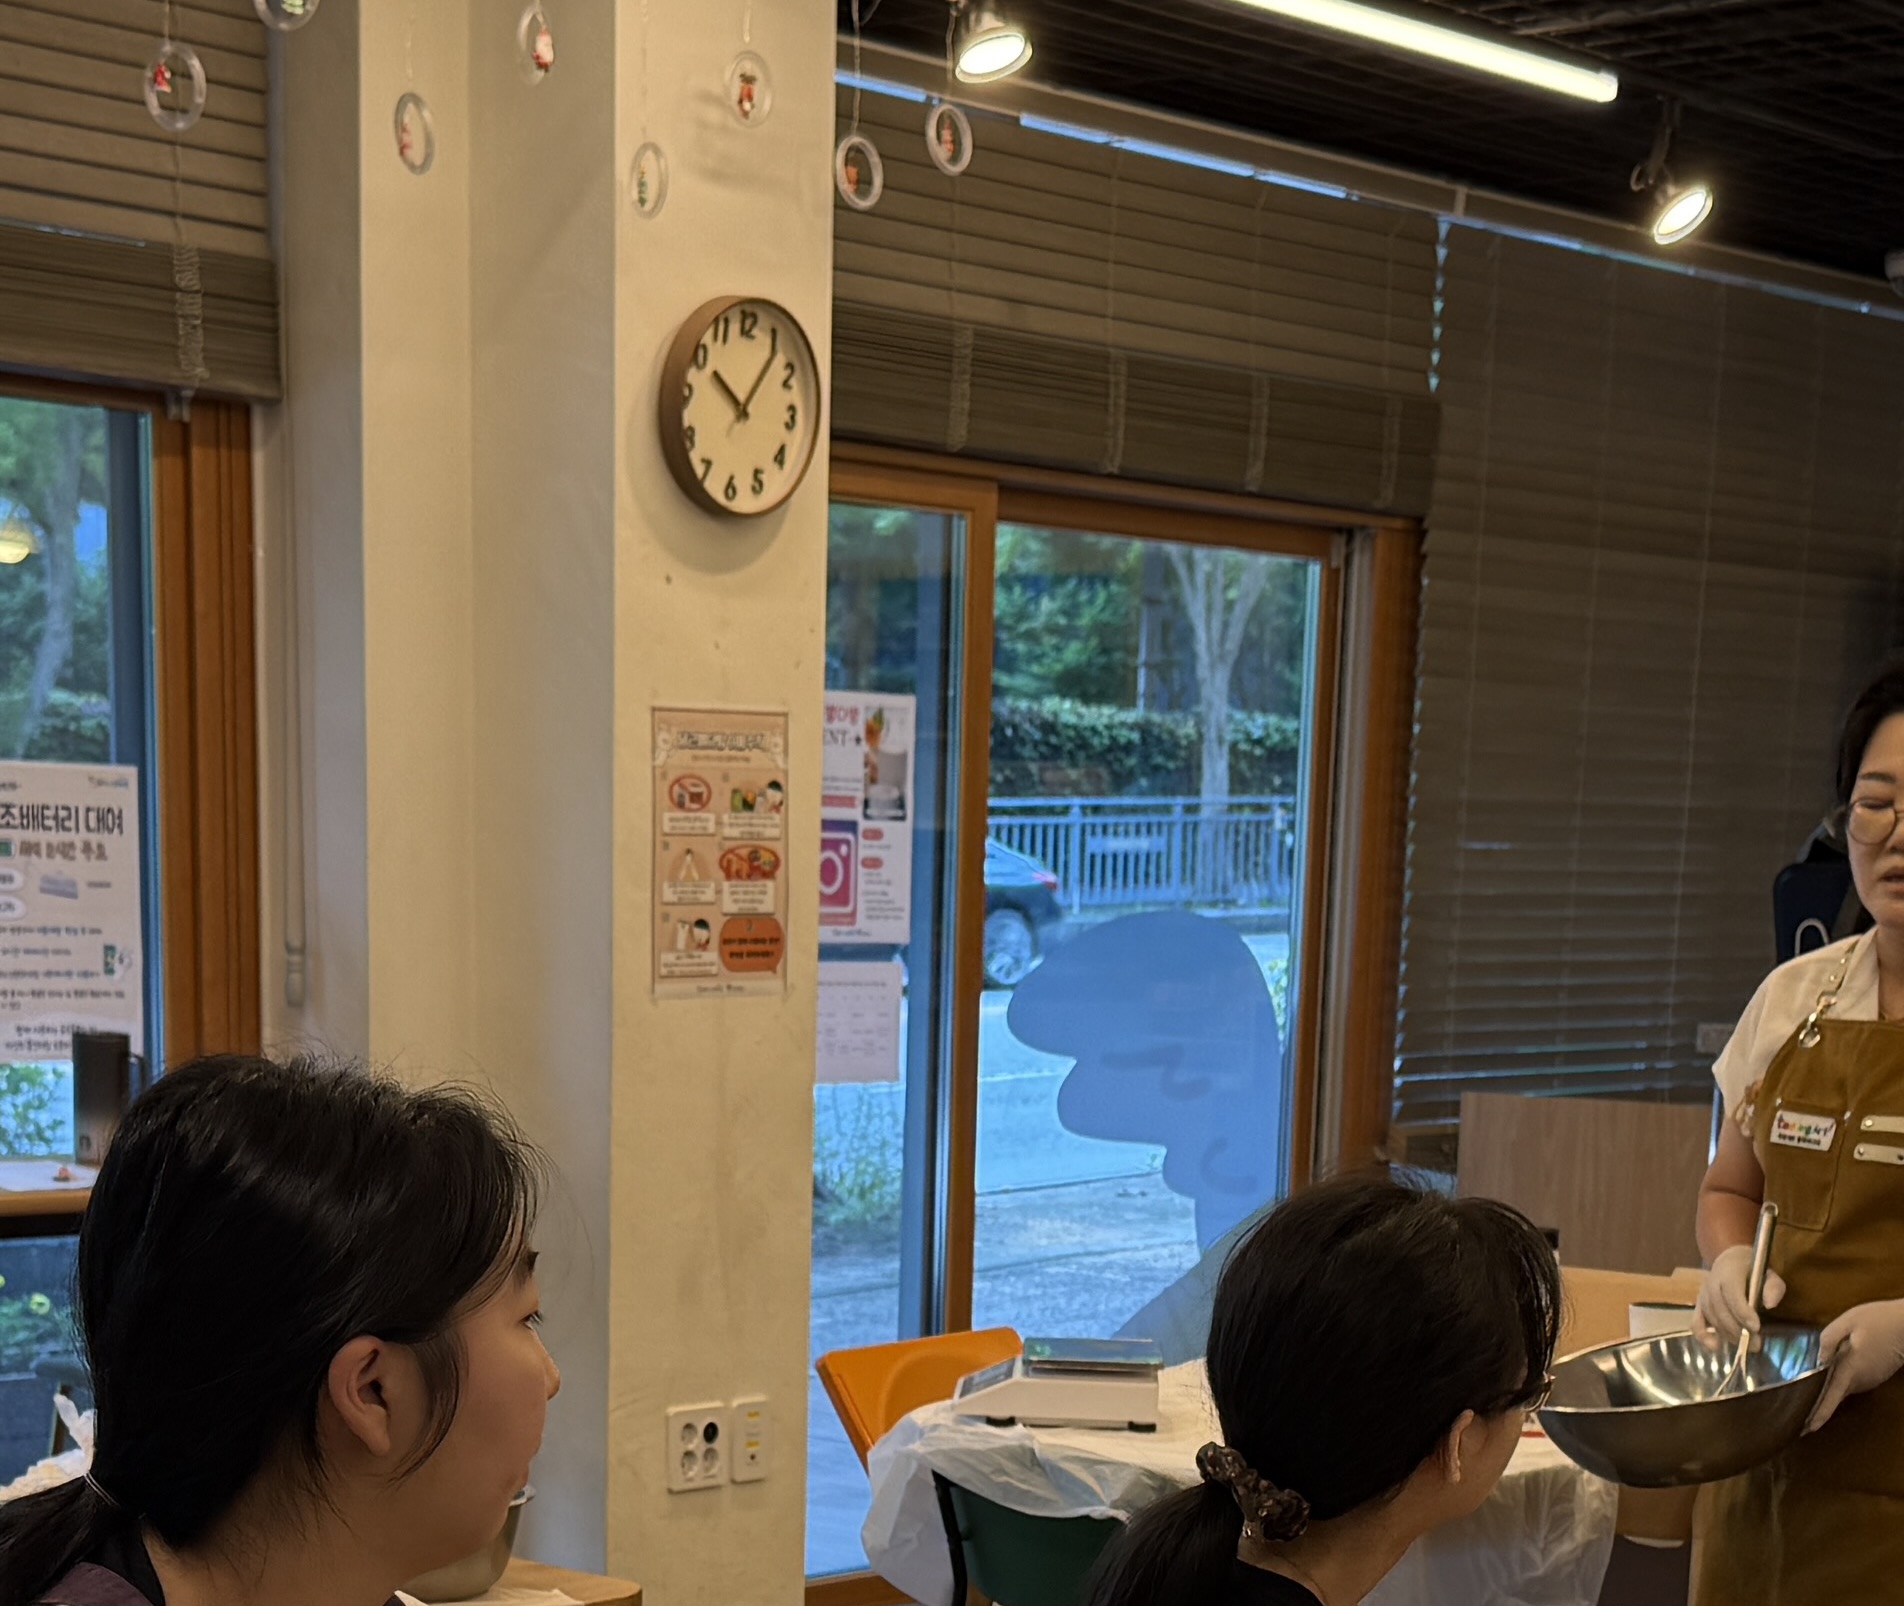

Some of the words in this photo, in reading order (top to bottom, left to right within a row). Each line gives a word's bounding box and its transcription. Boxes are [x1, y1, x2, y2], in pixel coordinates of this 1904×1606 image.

[712, 317, 729, 345] 11
[740, 309, 758, 339] 12
[694, 343, 708, 370] 0
[782, 362, 795, 390] 2
[784, 404, 796, 431] 3
[700, 457, 713, 482] 7
[774, 443, 786, 470] 4
[724, 474, 737, 501] 6
[751, 468, 764, 495] 5
[84, 805, 124, 836] 대여
